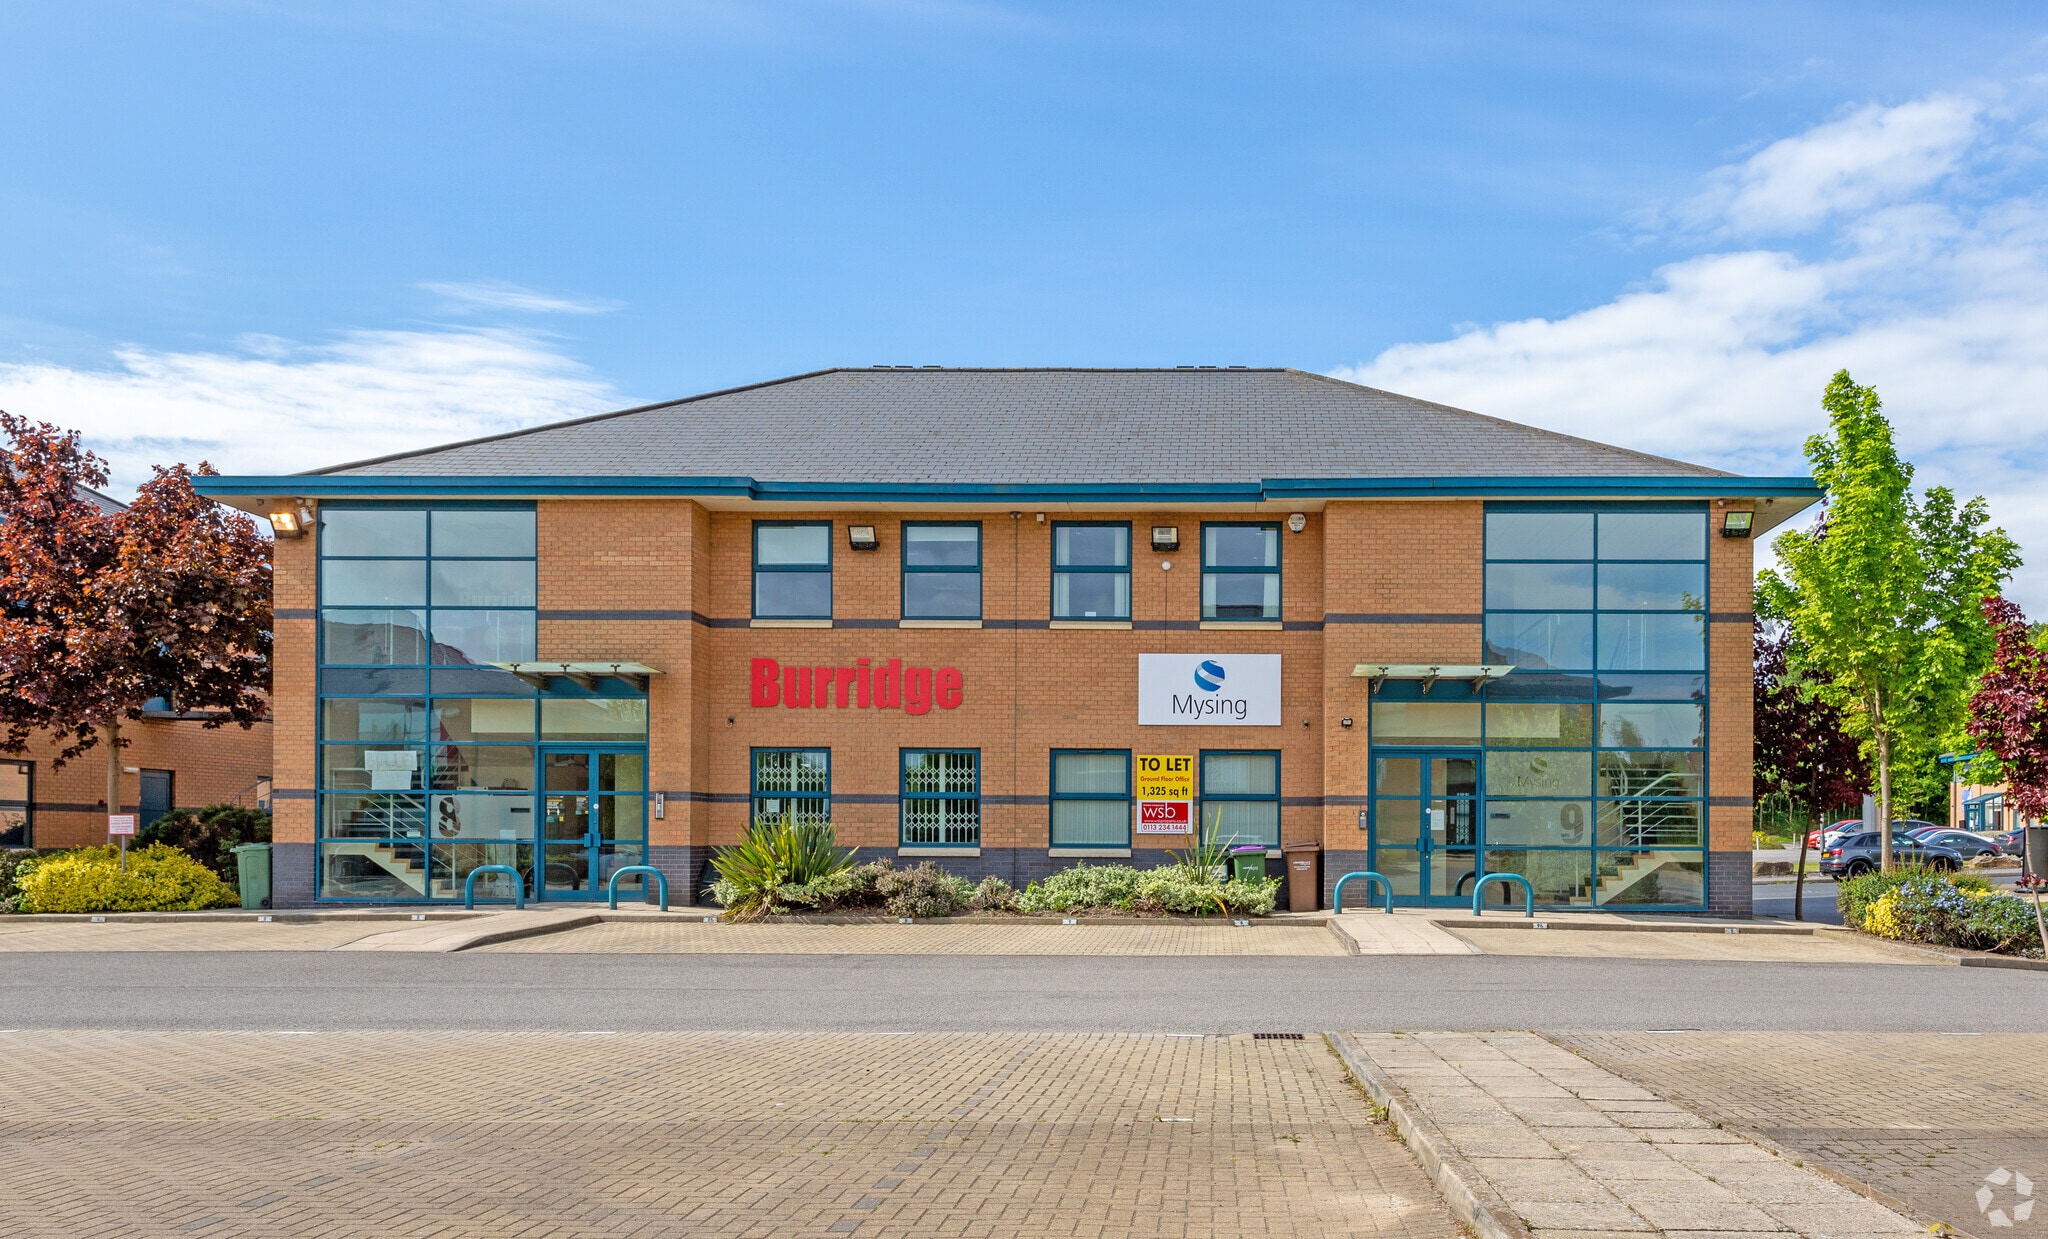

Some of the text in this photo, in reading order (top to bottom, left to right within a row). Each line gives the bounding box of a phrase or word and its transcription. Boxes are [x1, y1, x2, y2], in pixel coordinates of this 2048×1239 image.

[751, 657, 963, 716] Burridge
[1172, 693, 1247, 720] Mysing
[1140, 758, 1191, 771] TO LET
[1142, 786, 1188, 798] 1,325 sq ft
[438, 796, 461, 837] 8
[1143, 802, 1176, 818] wsb
[1560, 803, 1584, 844] 9
